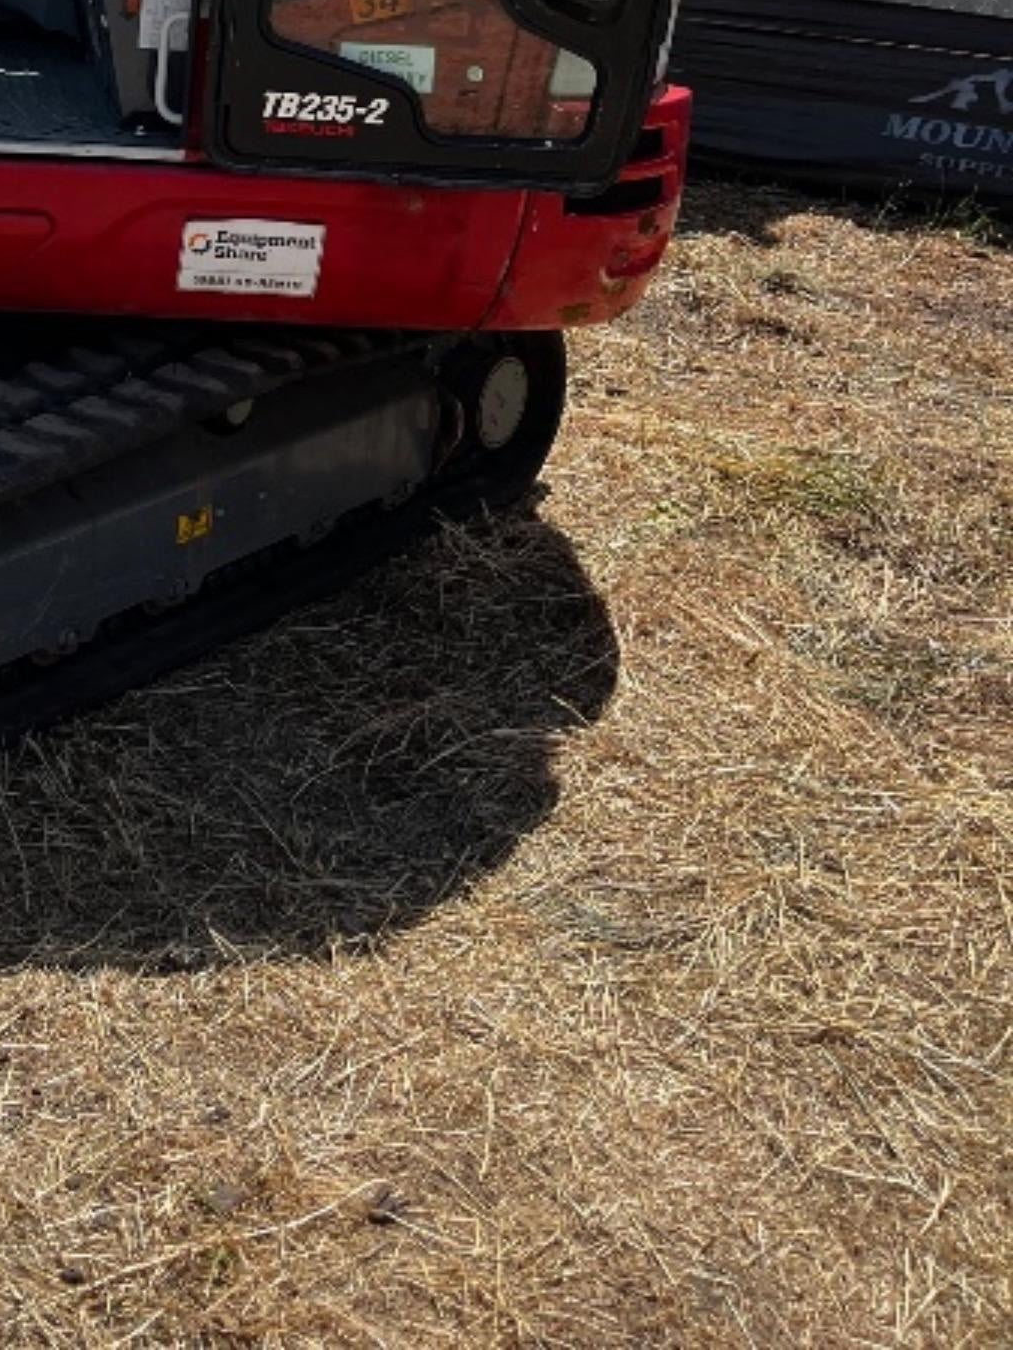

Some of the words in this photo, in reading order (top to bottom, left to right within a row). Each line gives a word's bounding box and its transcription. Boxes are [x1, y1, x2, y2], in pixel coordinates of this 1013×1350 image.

[262, 90, 390, 124] TB235-2
[214, 230, 316, 249] Equipment
[214, 245, 268, 262] Share
